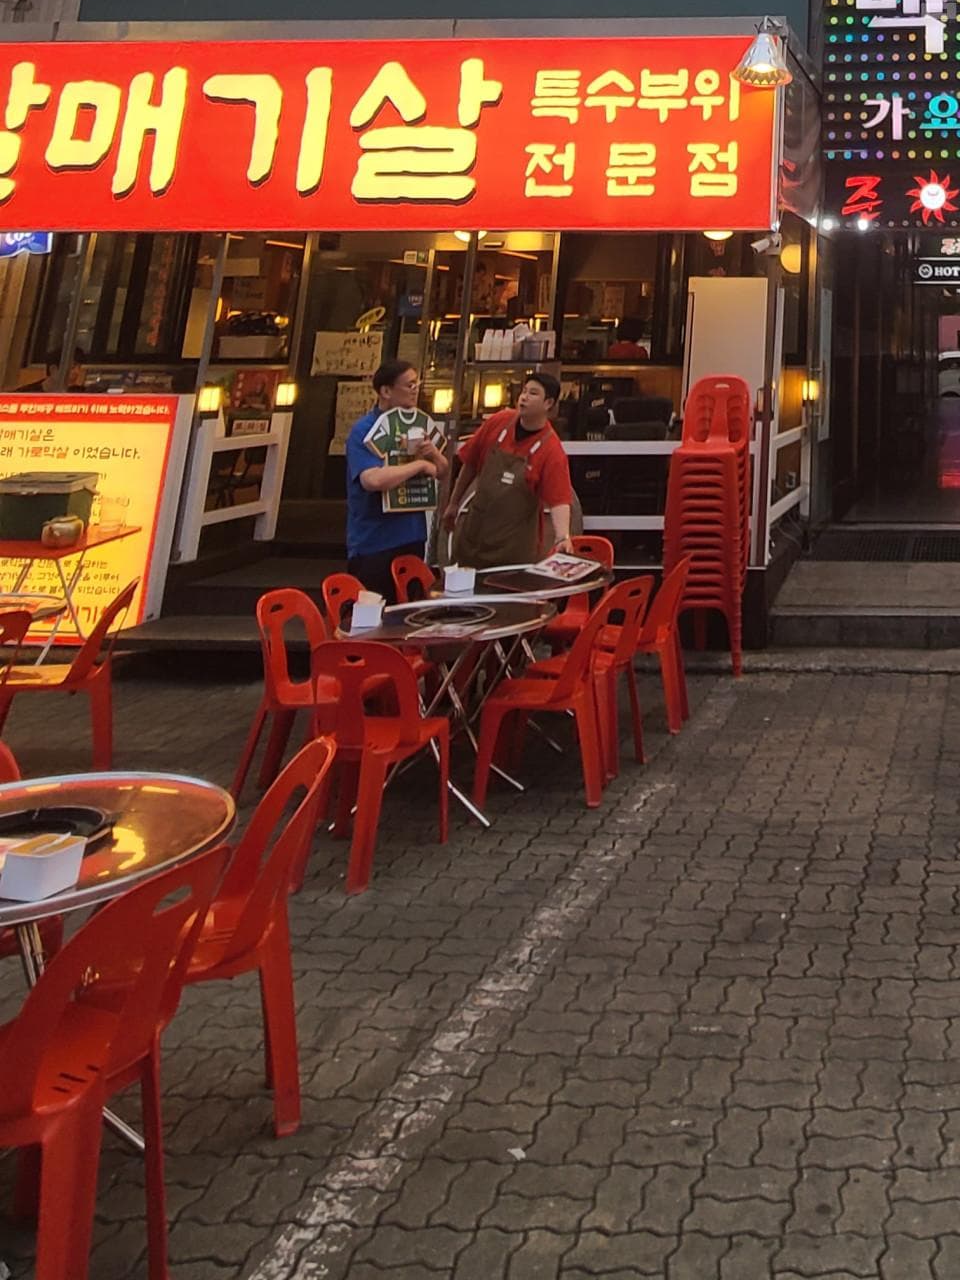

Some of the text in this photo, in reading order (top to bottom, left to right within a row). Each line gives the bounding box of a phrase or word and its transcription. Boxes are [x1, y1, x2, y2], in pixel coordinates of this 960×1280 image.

[530, 68, 742, 124] 특수부위
[524, 142, 740, 198] 전문점
[73, 446, 142, 460] 이었습니다.
